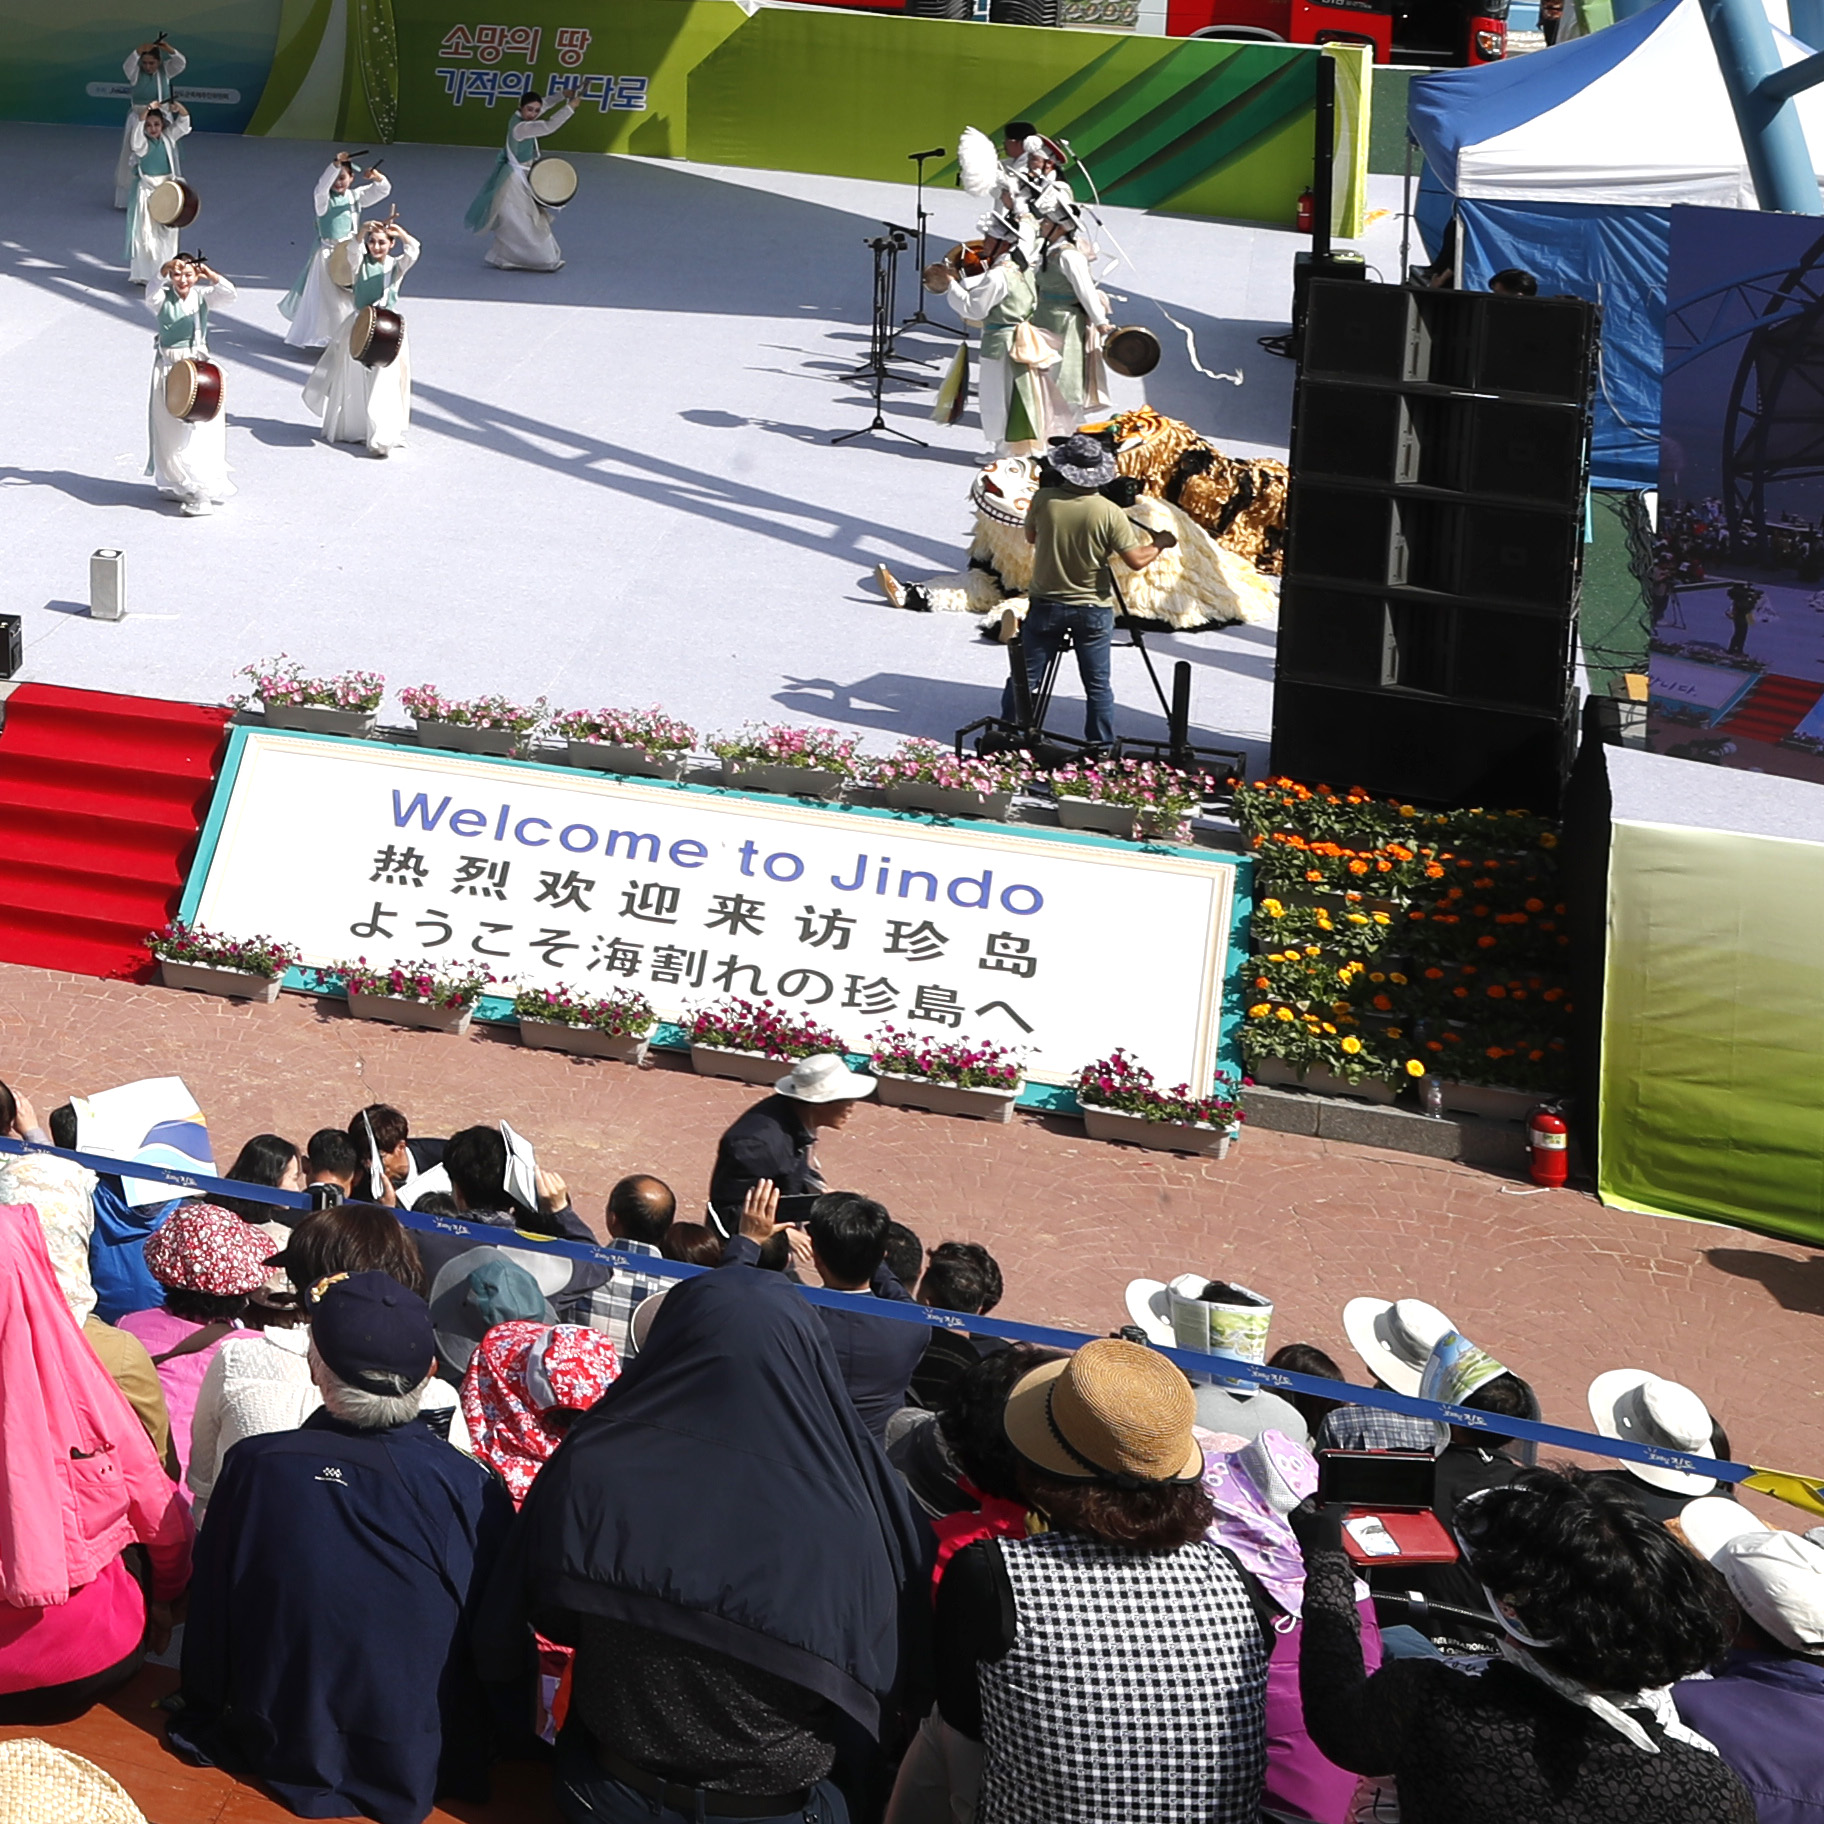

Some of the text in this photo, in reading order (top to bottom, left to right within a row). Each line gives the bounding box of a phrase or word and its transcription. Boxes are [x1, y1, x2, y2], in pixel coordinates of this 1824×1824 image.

[436, 68, 648, 112] 기적의 바다로
[439, 25, 591, 67] 소망의 땅
[369, 843, 1039, 979] 热烈欢迎来访珍岛
[390, 788, 1045, 917] Welcome to Jindo
[348, 900, 1036, 1034] ようこそ海割れの珍島へ
